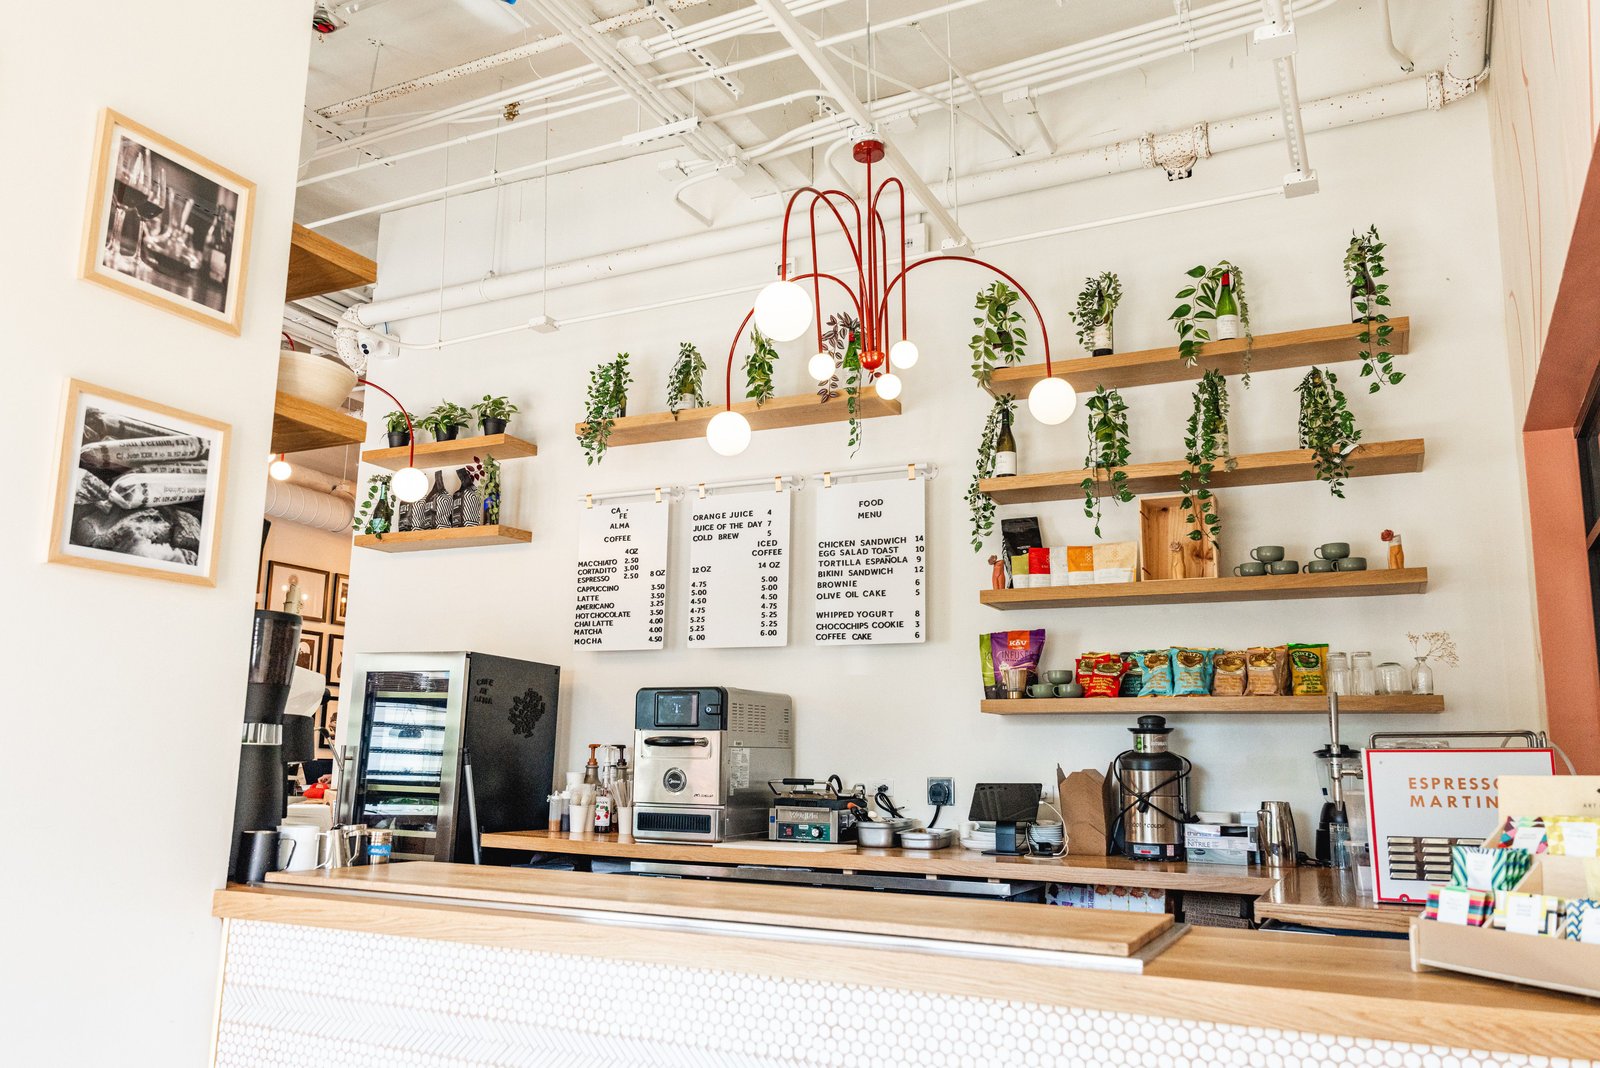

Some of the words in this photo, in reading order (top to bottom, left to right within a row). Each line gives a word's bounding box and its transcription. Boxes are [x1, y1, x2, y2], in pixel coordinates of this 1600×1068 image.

[858, 498, 884, 508] FOOD
[692, 512, 727, 522] ORANGE
[729, 510, 754, 519] JUICE
[857, 510, 882, 519] MENU
[609, 522, 630, 530] ALMA
[692, 523, 715, 533] JUICE
[729, 521, 744, 530] THE
[747, 520, 763, 529] DAY
[603, 534, 631, 543] COFFEE
[692, 534, 713, 543] COLD
[718, 532, 740, 541] BREW
[757, 539, 778, 548] ICED
[818, 539, 856, 549] CHICKEN
[860, 536, 907, 547] SANDWICH
[751, 548, 783, 557] COFFEE
[818, 549, 836, 558] EGG
[839, 548, 869, 557] SALAD
[871, 546, 899, 555] TOAST
[577, 558, 618, 568] MACCHIATO
[818, 558, 862, 568] TORTILLA
[865, 554, 909, 566] ESPAÑOLA
[577, 566, 618, 576] CORTADITO
[817, 569, 844, 578] BIKINI
[848, 567, 894, 577] SANDWICH
[577, 575, 611, 584] ESPRESSO
[576, 584, 620, 593] CAPPUCCINO
[817, 580, 858, 589] BROWNIE
[576, 594, 600, 602] LATTE
[815, 591, 841, 601] OLIVE
[844, 591, 860, 599] OIL
[862, 589, 887, 598] CAKE
[575, 602, 615, 611] AMERICANO
[815, 611, 855, 619] WHIPPED
[573, 620, 591, 628] CHAI
[591, 619, 614, 627] LATTE
[815, 622, 869, 631] CHOCOCHIPS
[871, 620, 905, 629] COOKIE
[573, 628, 603, 636] MATCHA
[815, 632, 847, 641] COFFEE
[851, 632, 872, 641] CAKE
[573, 637, 603, 645] MOCHA
